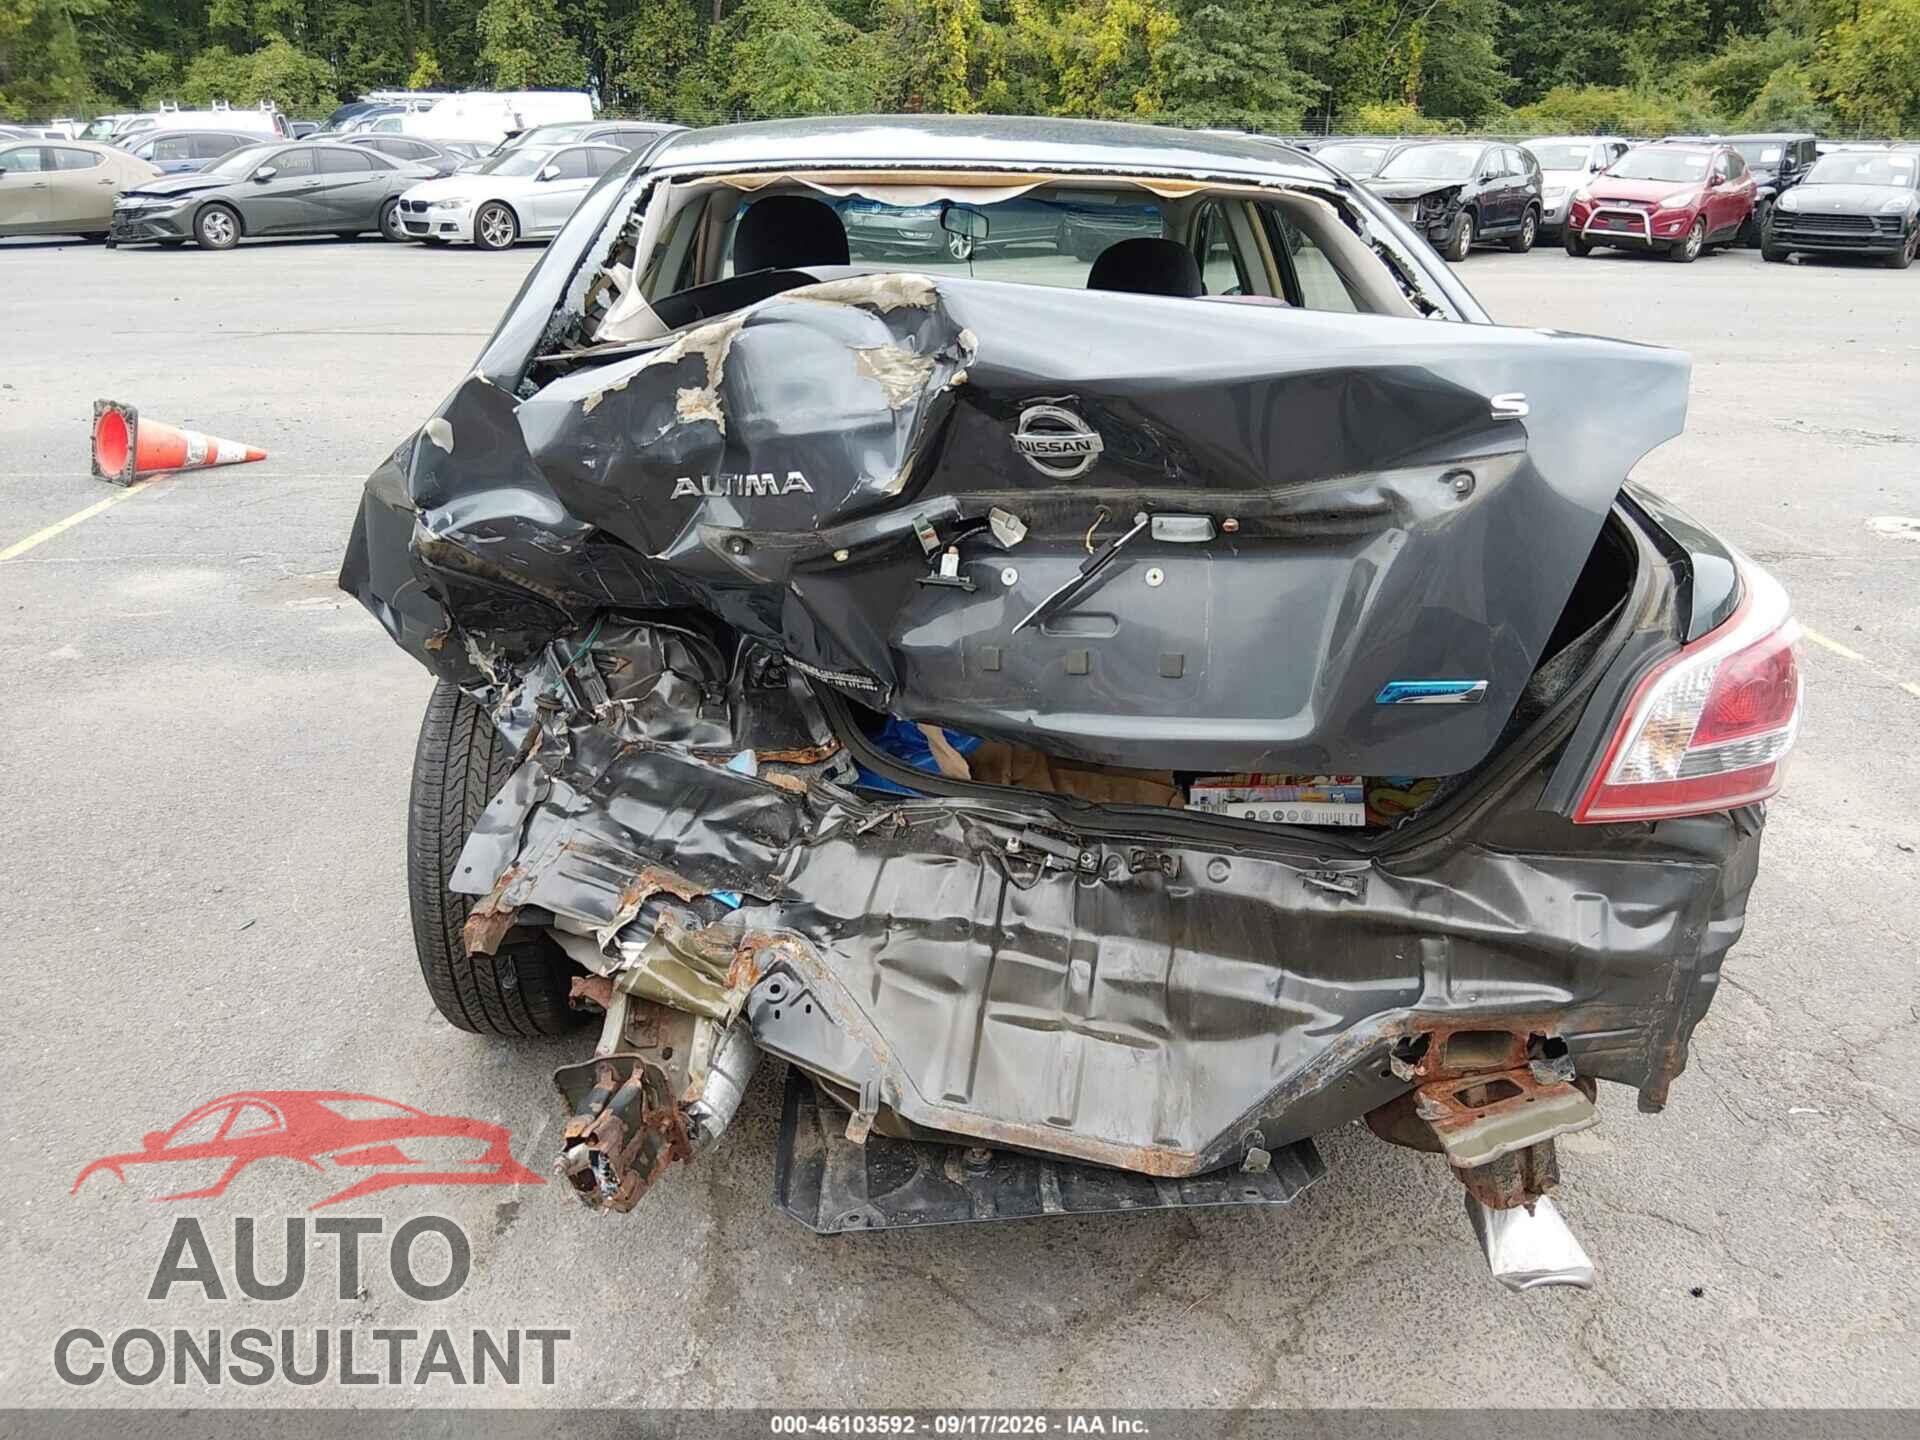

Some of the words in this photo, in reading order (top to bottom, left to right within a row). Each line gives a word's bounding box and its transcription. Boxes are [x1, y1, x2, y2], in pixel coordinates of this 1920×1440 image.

[1490, 392, 1529, 421] S
[1018, 439, 1092, 453] NISSAN
[670, 471, 814, 500] ALTIMA
